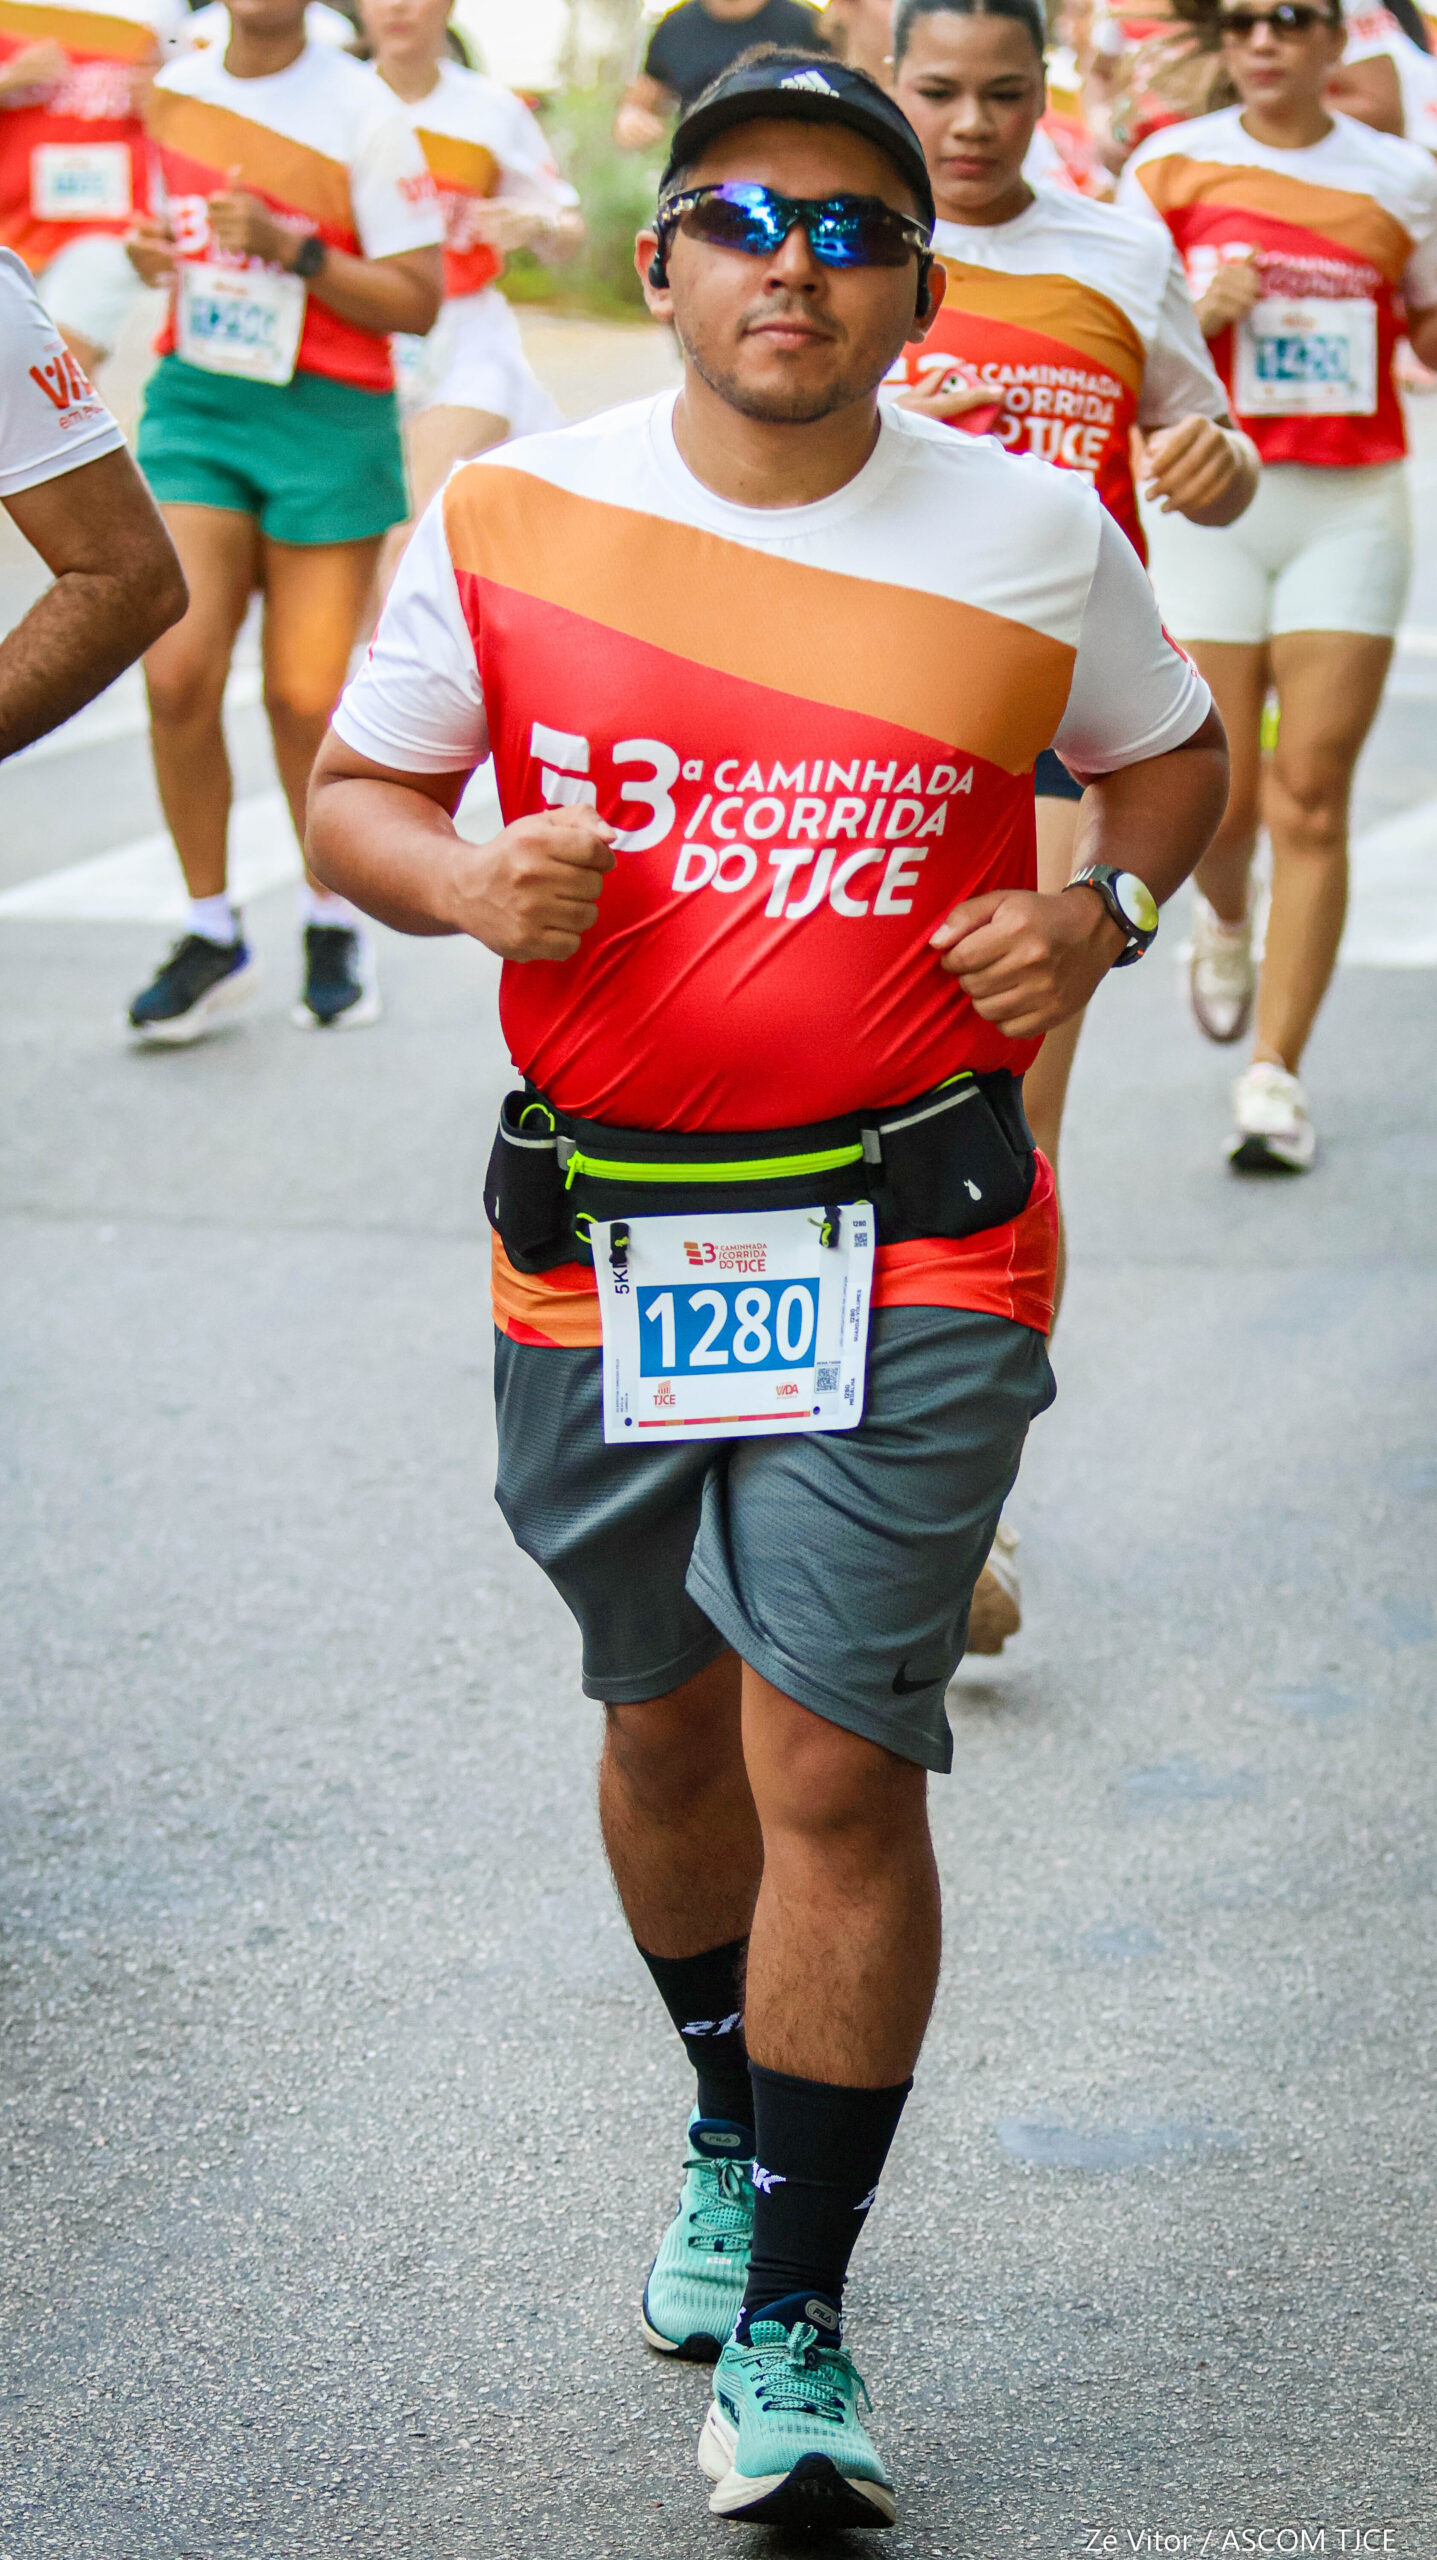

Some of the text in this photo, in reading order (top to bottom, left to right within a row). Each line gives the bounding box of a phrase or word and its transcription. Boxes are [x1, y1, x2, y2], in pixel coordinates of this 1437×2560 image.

[1004, 386, 1115, 424] ORRIDA
[714, 760, 974, 796] CAMINHADA
[672, 844, 928, 919] DO TJCE
[719, 1242, 768, 1252] CAMINHADA
[719, 1259, 766, 1273] DO TJCE
[644, 1284, 815, 1368] 1280
[653, 1394, 676, 1406] TJCE
[681, 2012, 743, 2035] 21
[812, 2307, 833, 2325] FILA
